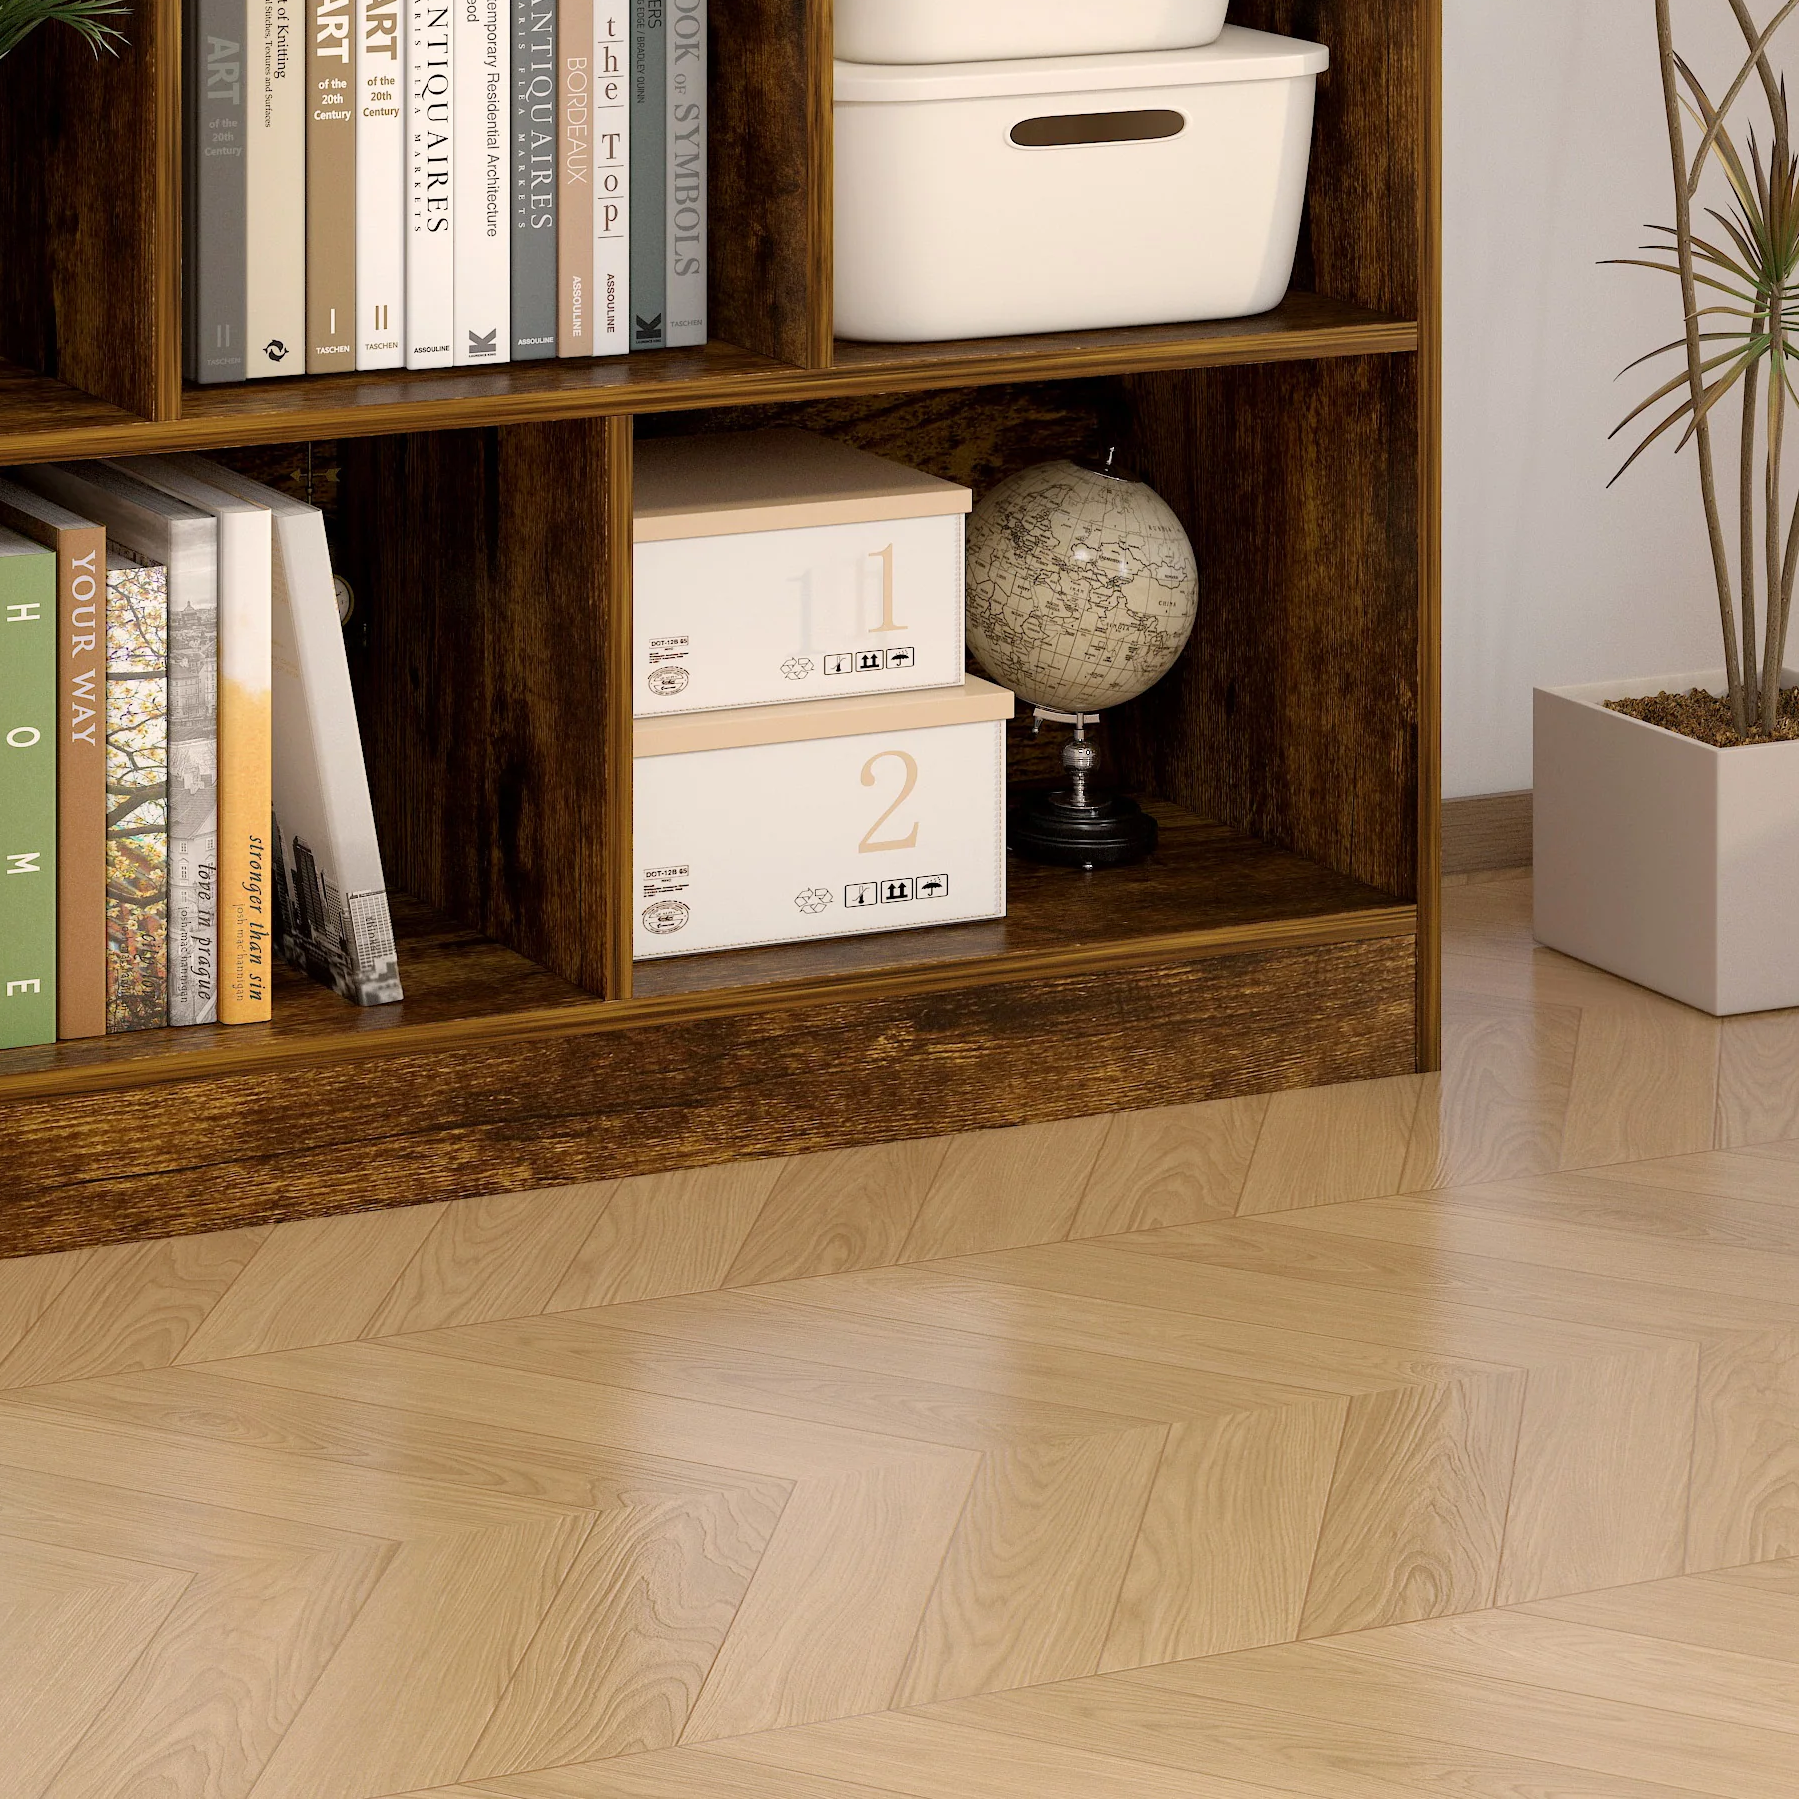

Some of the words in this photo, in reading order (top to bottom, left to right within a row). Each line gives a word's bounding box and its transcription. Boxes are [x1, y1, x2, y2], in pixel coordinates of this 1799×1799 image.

[277, 7, 290, 21] of
[264, 41, 273, 77] Textures
[273, 24, 290, 79] Knitting
[603, 17, 619, 101] the
[264, 78, 273, 92] and
[264, 94, 273, 128] Surfaces
[318, 78, 329, 89] of
[331, 78, 347, 89] the
[321, 94, 343, 104] 20th
[487, 73, 500, 149] Residential
[674, 73, 686, 95] OF
[314, 110, 351, 121] Century
[567, 57, 587, 184] BORDEAUX
[487, 154, 500, 237] Architecture
[602, 132, 621, 232] Top
[674, 104, 701, 278] SYMBOLS
[572, 275, 581, 337] ASSOULINE
[606, 273, 615, 334] ASSOULINE
[316, 345, 350, 354] TASCHEN
[414, 345, 450, 354] ASSOULINE
[71, 549, 96, 658] YOUR
[71, 668, 96, 746] WAY
[6, 603, 41, 996] HOME
[857, 750, 920, 854] 2
[242, 835, 264, 913] stronger
[198, 909, 215, 927] in
[249, 922, 270, 965] than
[191, 936, 211, 1000] prague
[249, 973, 265, 1001] sin
